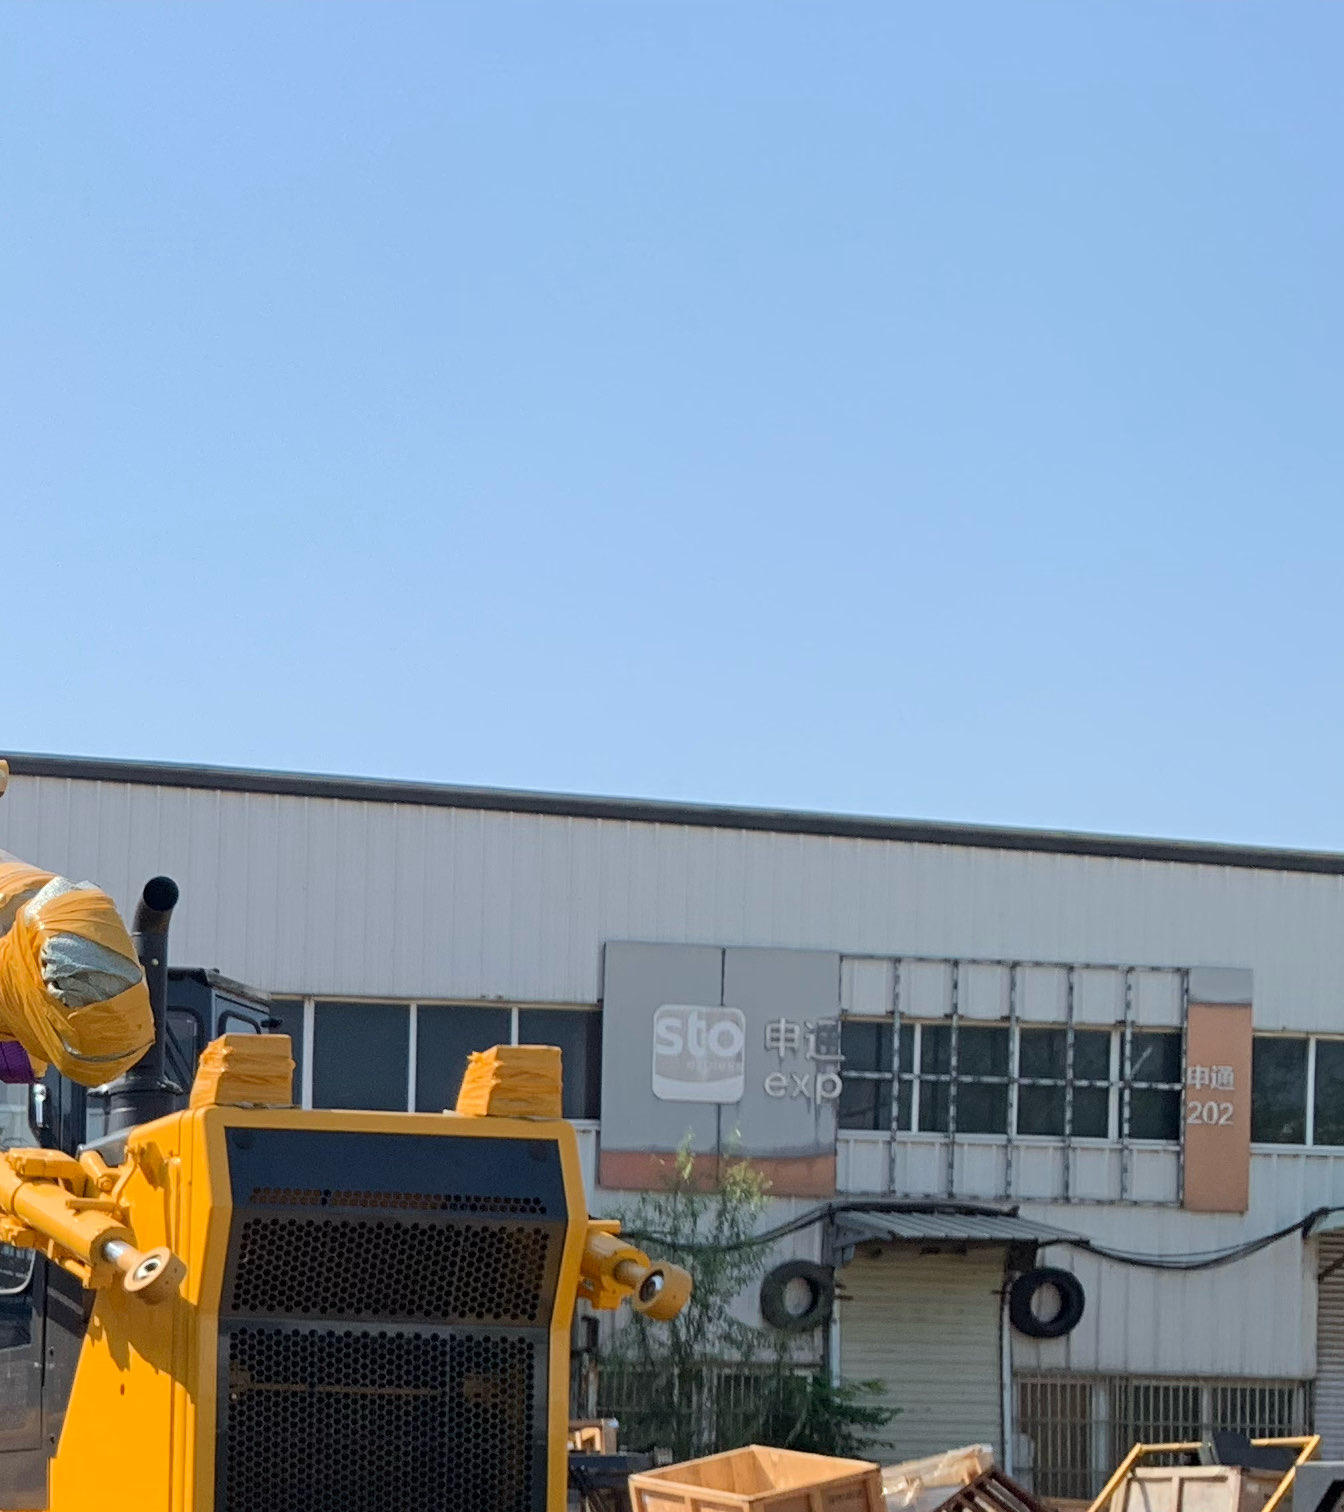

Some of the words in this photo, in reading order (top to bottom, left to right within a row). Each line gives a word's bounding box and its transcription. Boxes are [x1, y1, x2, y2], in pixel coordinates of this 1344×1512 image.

[764, 1071, 843, 1105] exp
[1187, 1065, 1235, 1091] 申通
[1186, 1101, 1234, 1126] 202
